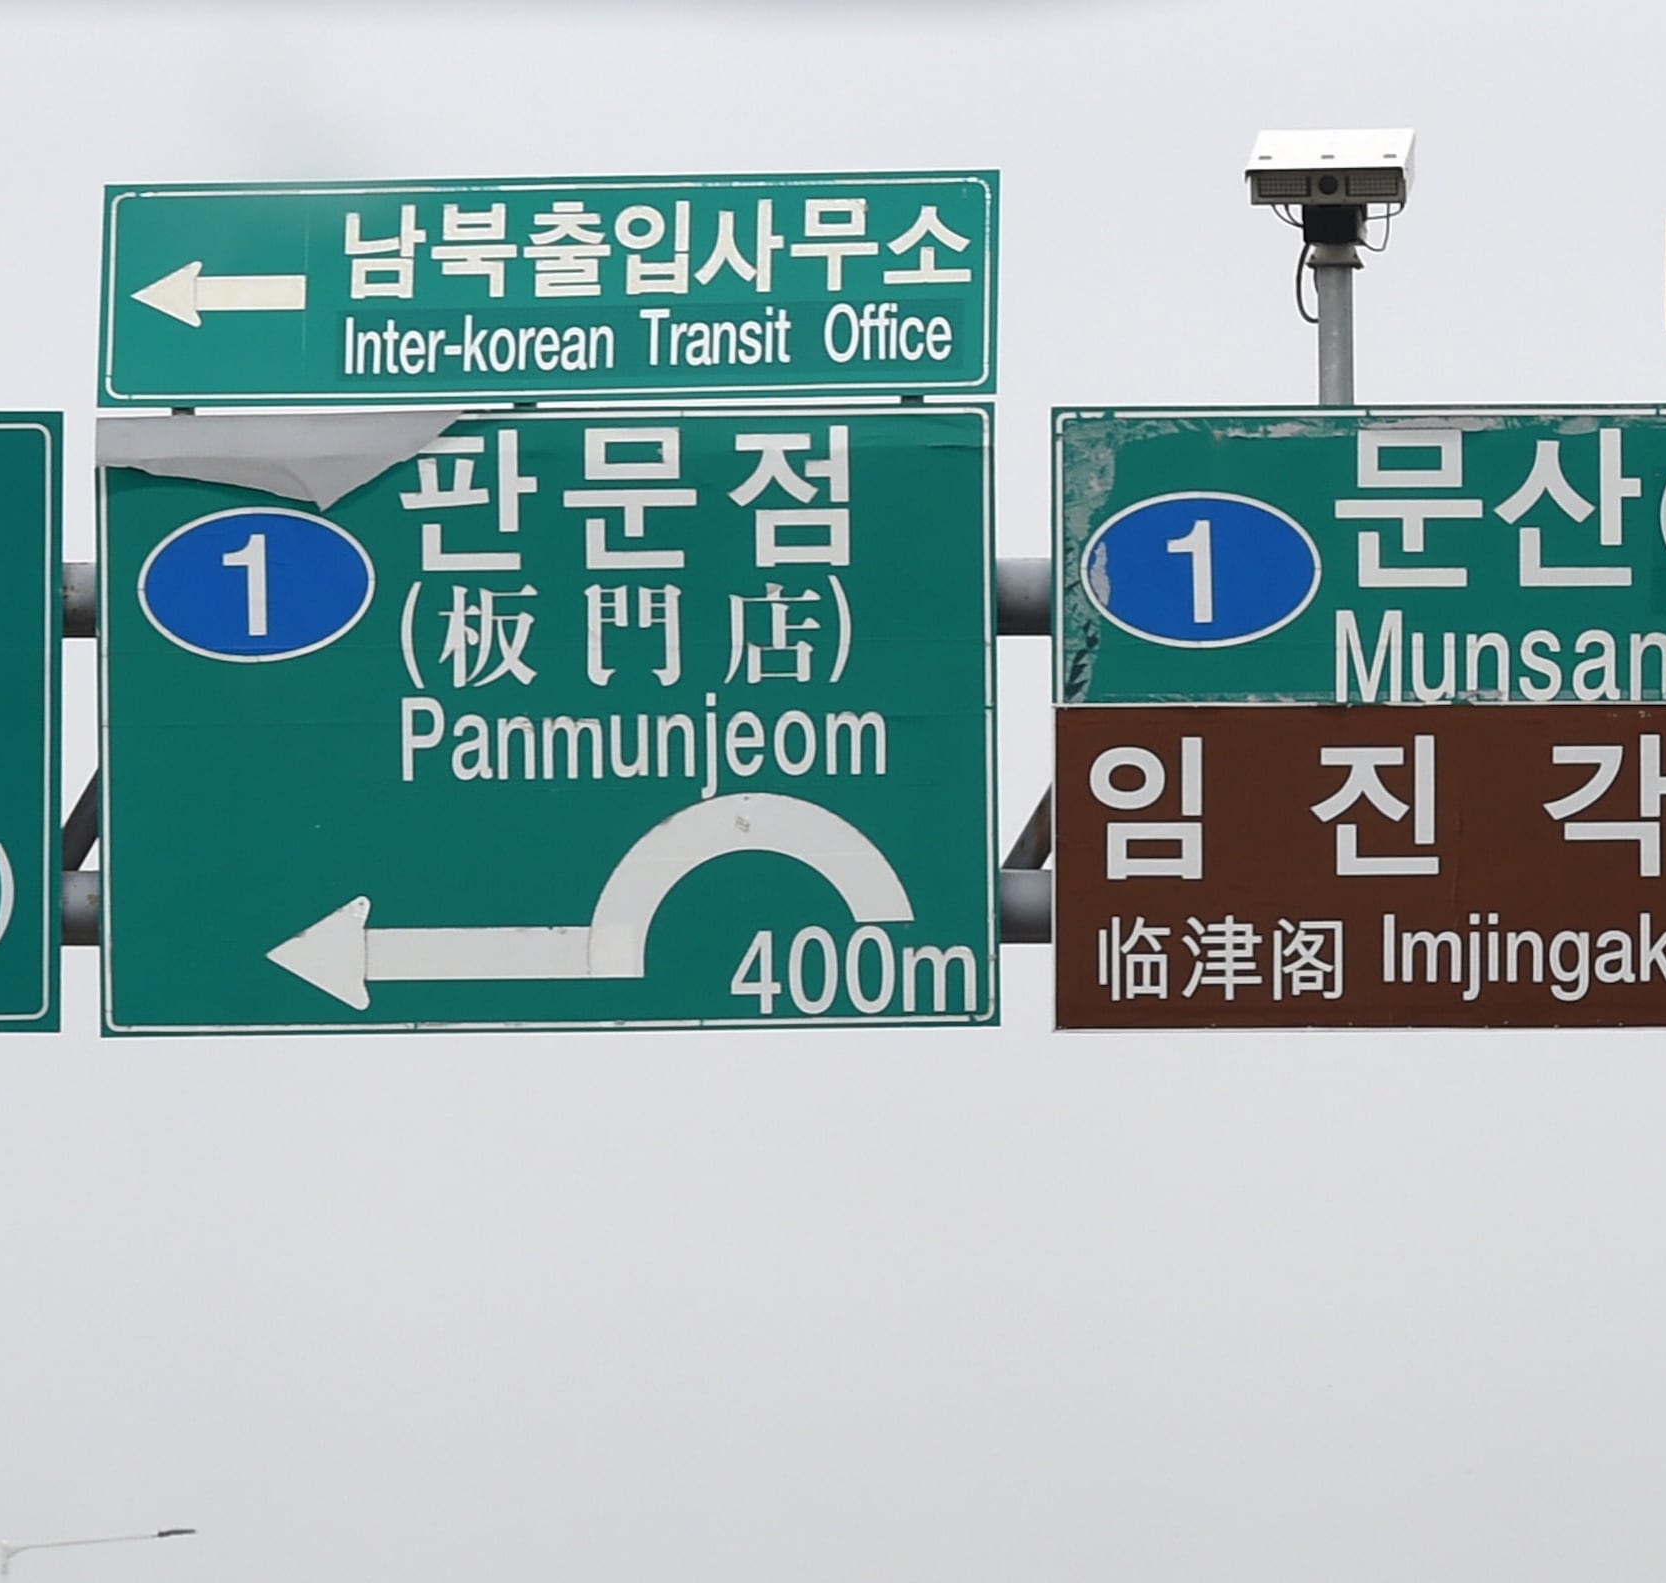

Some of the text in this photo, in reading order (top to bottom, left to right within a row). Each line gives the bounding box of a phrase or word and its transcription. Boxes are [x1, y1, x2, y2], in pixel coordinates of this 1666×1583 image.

[345, 199, 971, 299] 남북출입사무소
[345, 303, 951, 374] Inter-korean Transit Office
[399, 426, 849, 571] 판문점
[1335, 428, 1641, 587] 문산
[223, 534, 266, 636] 1
[1167, 519, 1213, 623] 1
[402, 693, 887, 798] Panmunjeom
[731, 926, 976, 1014] 400m
[1098, 915, 1343, 1001] 临津阁
